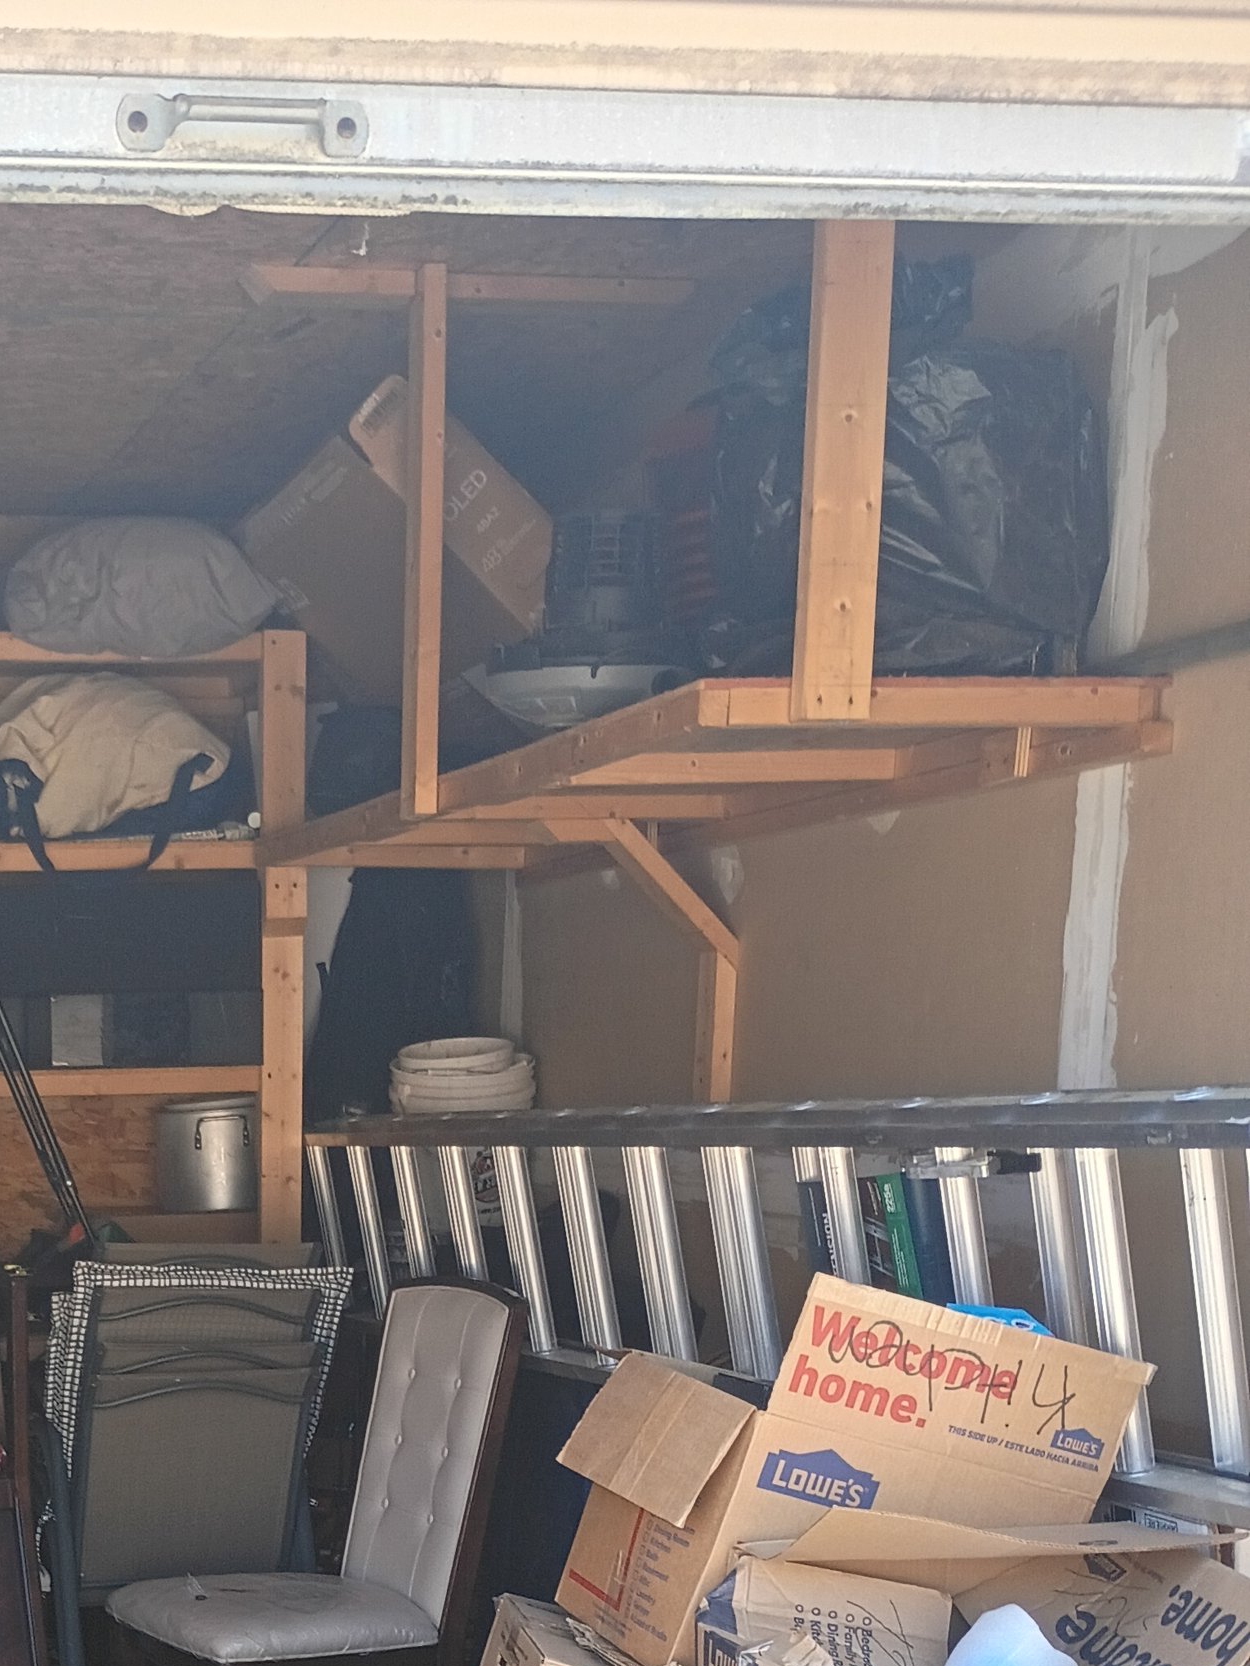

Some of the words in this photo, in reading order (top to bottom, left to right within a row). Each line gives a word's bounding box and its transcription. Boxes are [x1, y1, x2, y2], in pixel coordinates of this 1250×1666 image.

[812, 1305, 1018, 1400] Welcome
[788, 1354, 927, 1429] home.
[948, 1425, 965, 1438] THIS
[966, 1428, 982, 1442] SIDE
[982, 1432, 997, 1445] UP
[1004, 1438, 1024, 1453] ESTE
[1024, 1444, 1046, 1458] LADO
[769, 1465, 867, 1508] LOWE'S
